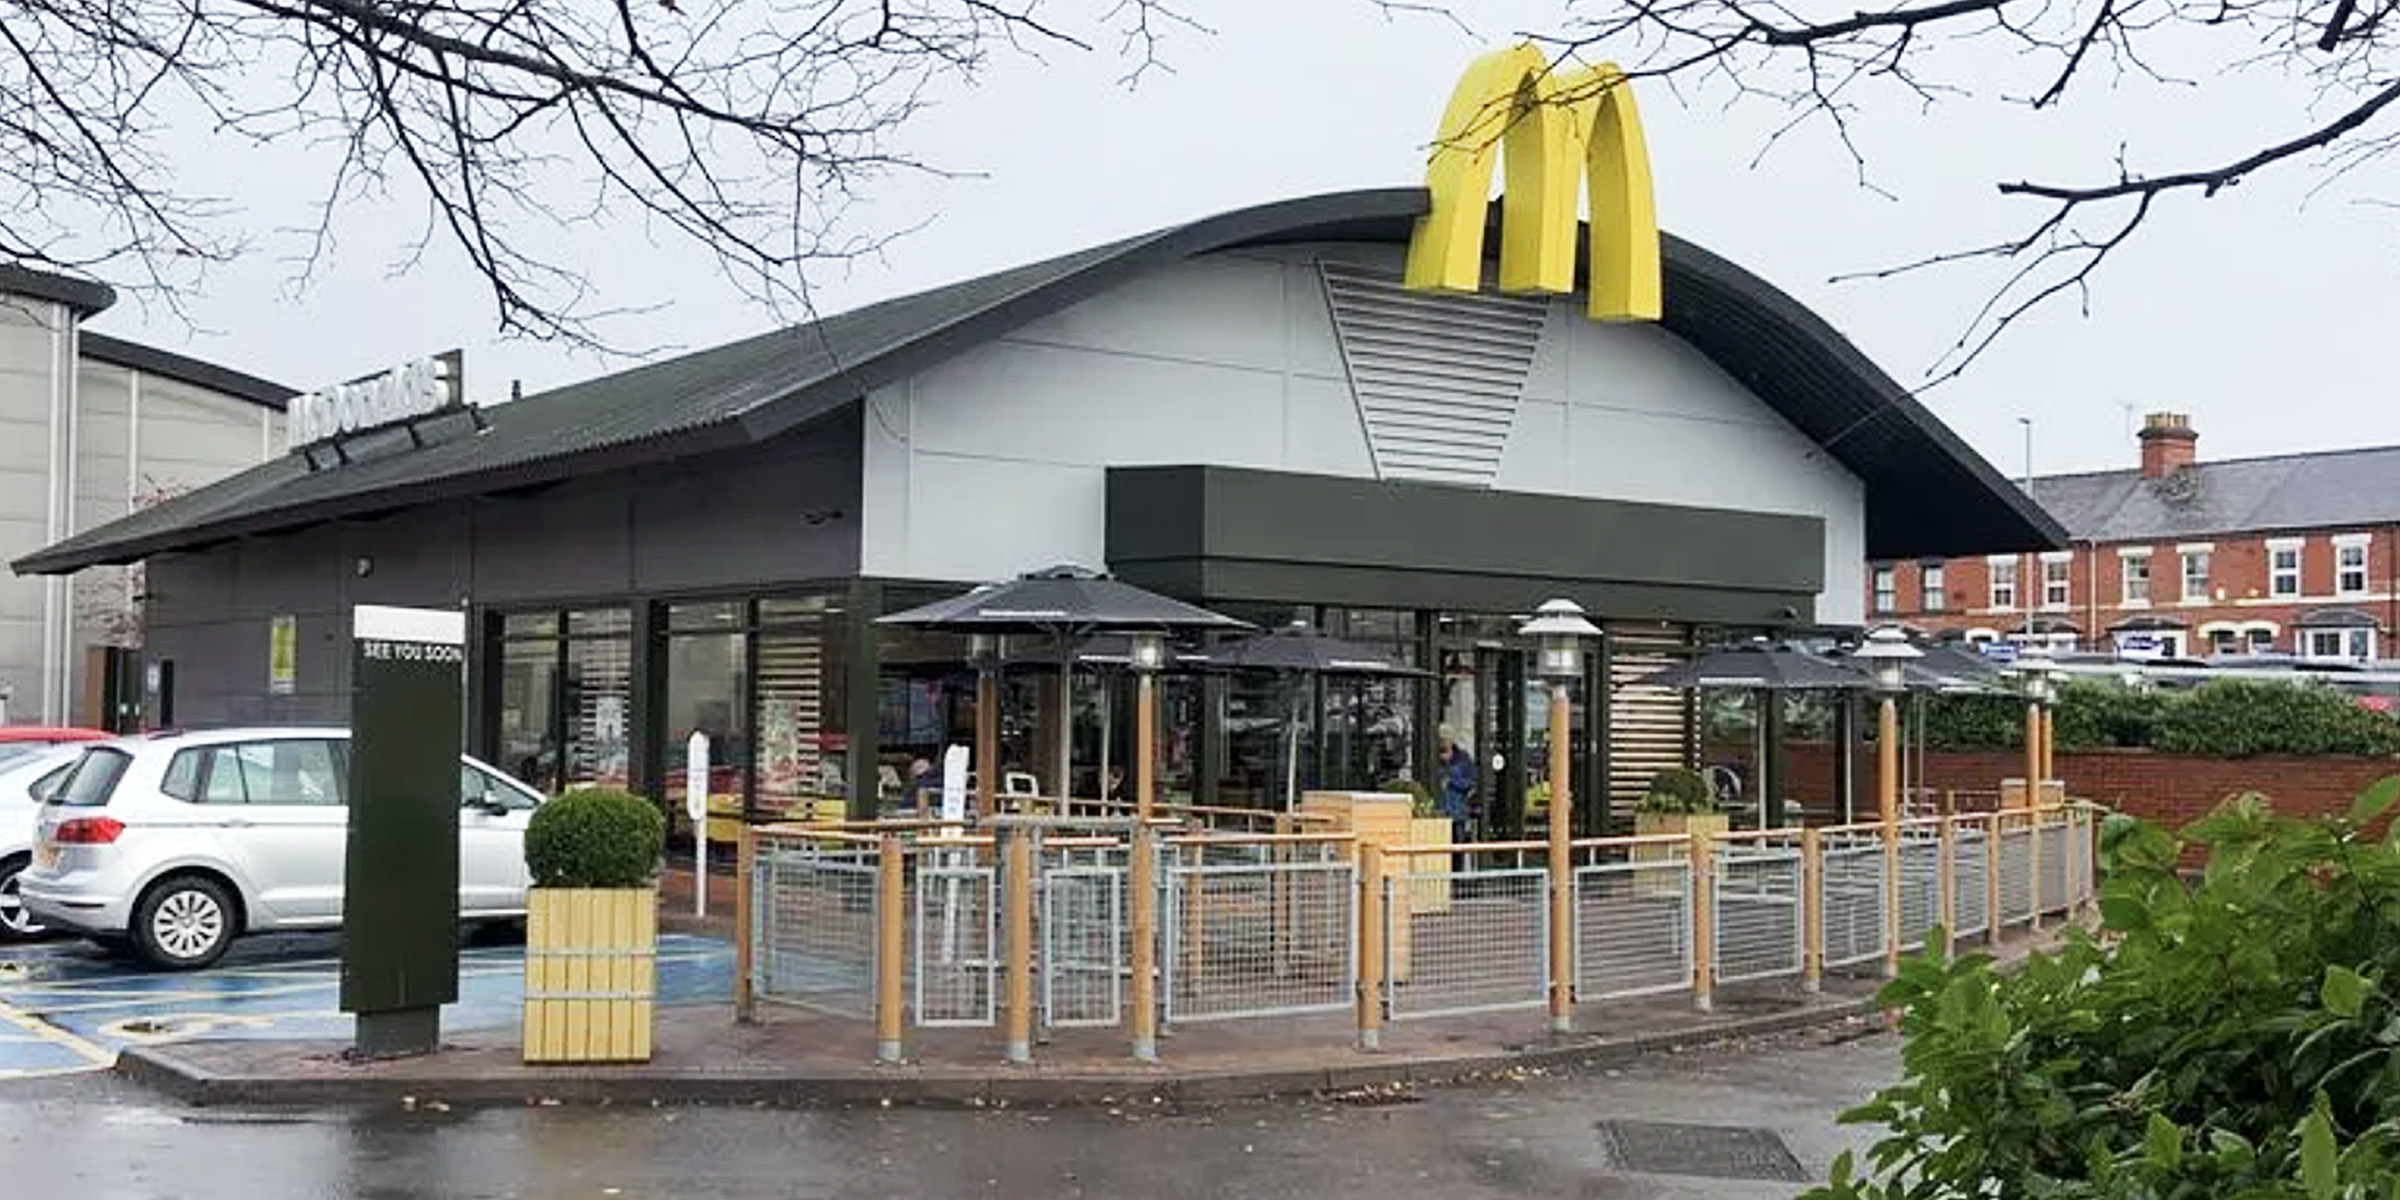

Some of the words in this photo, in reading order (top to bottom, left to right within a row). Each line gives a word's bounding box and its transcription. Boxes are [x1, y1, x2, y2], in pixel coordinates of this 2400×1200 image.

[363, 641, 391, 659] SEE
[394, 643, 422, 660] YOU
[424, 645, 463, 663] SOON
